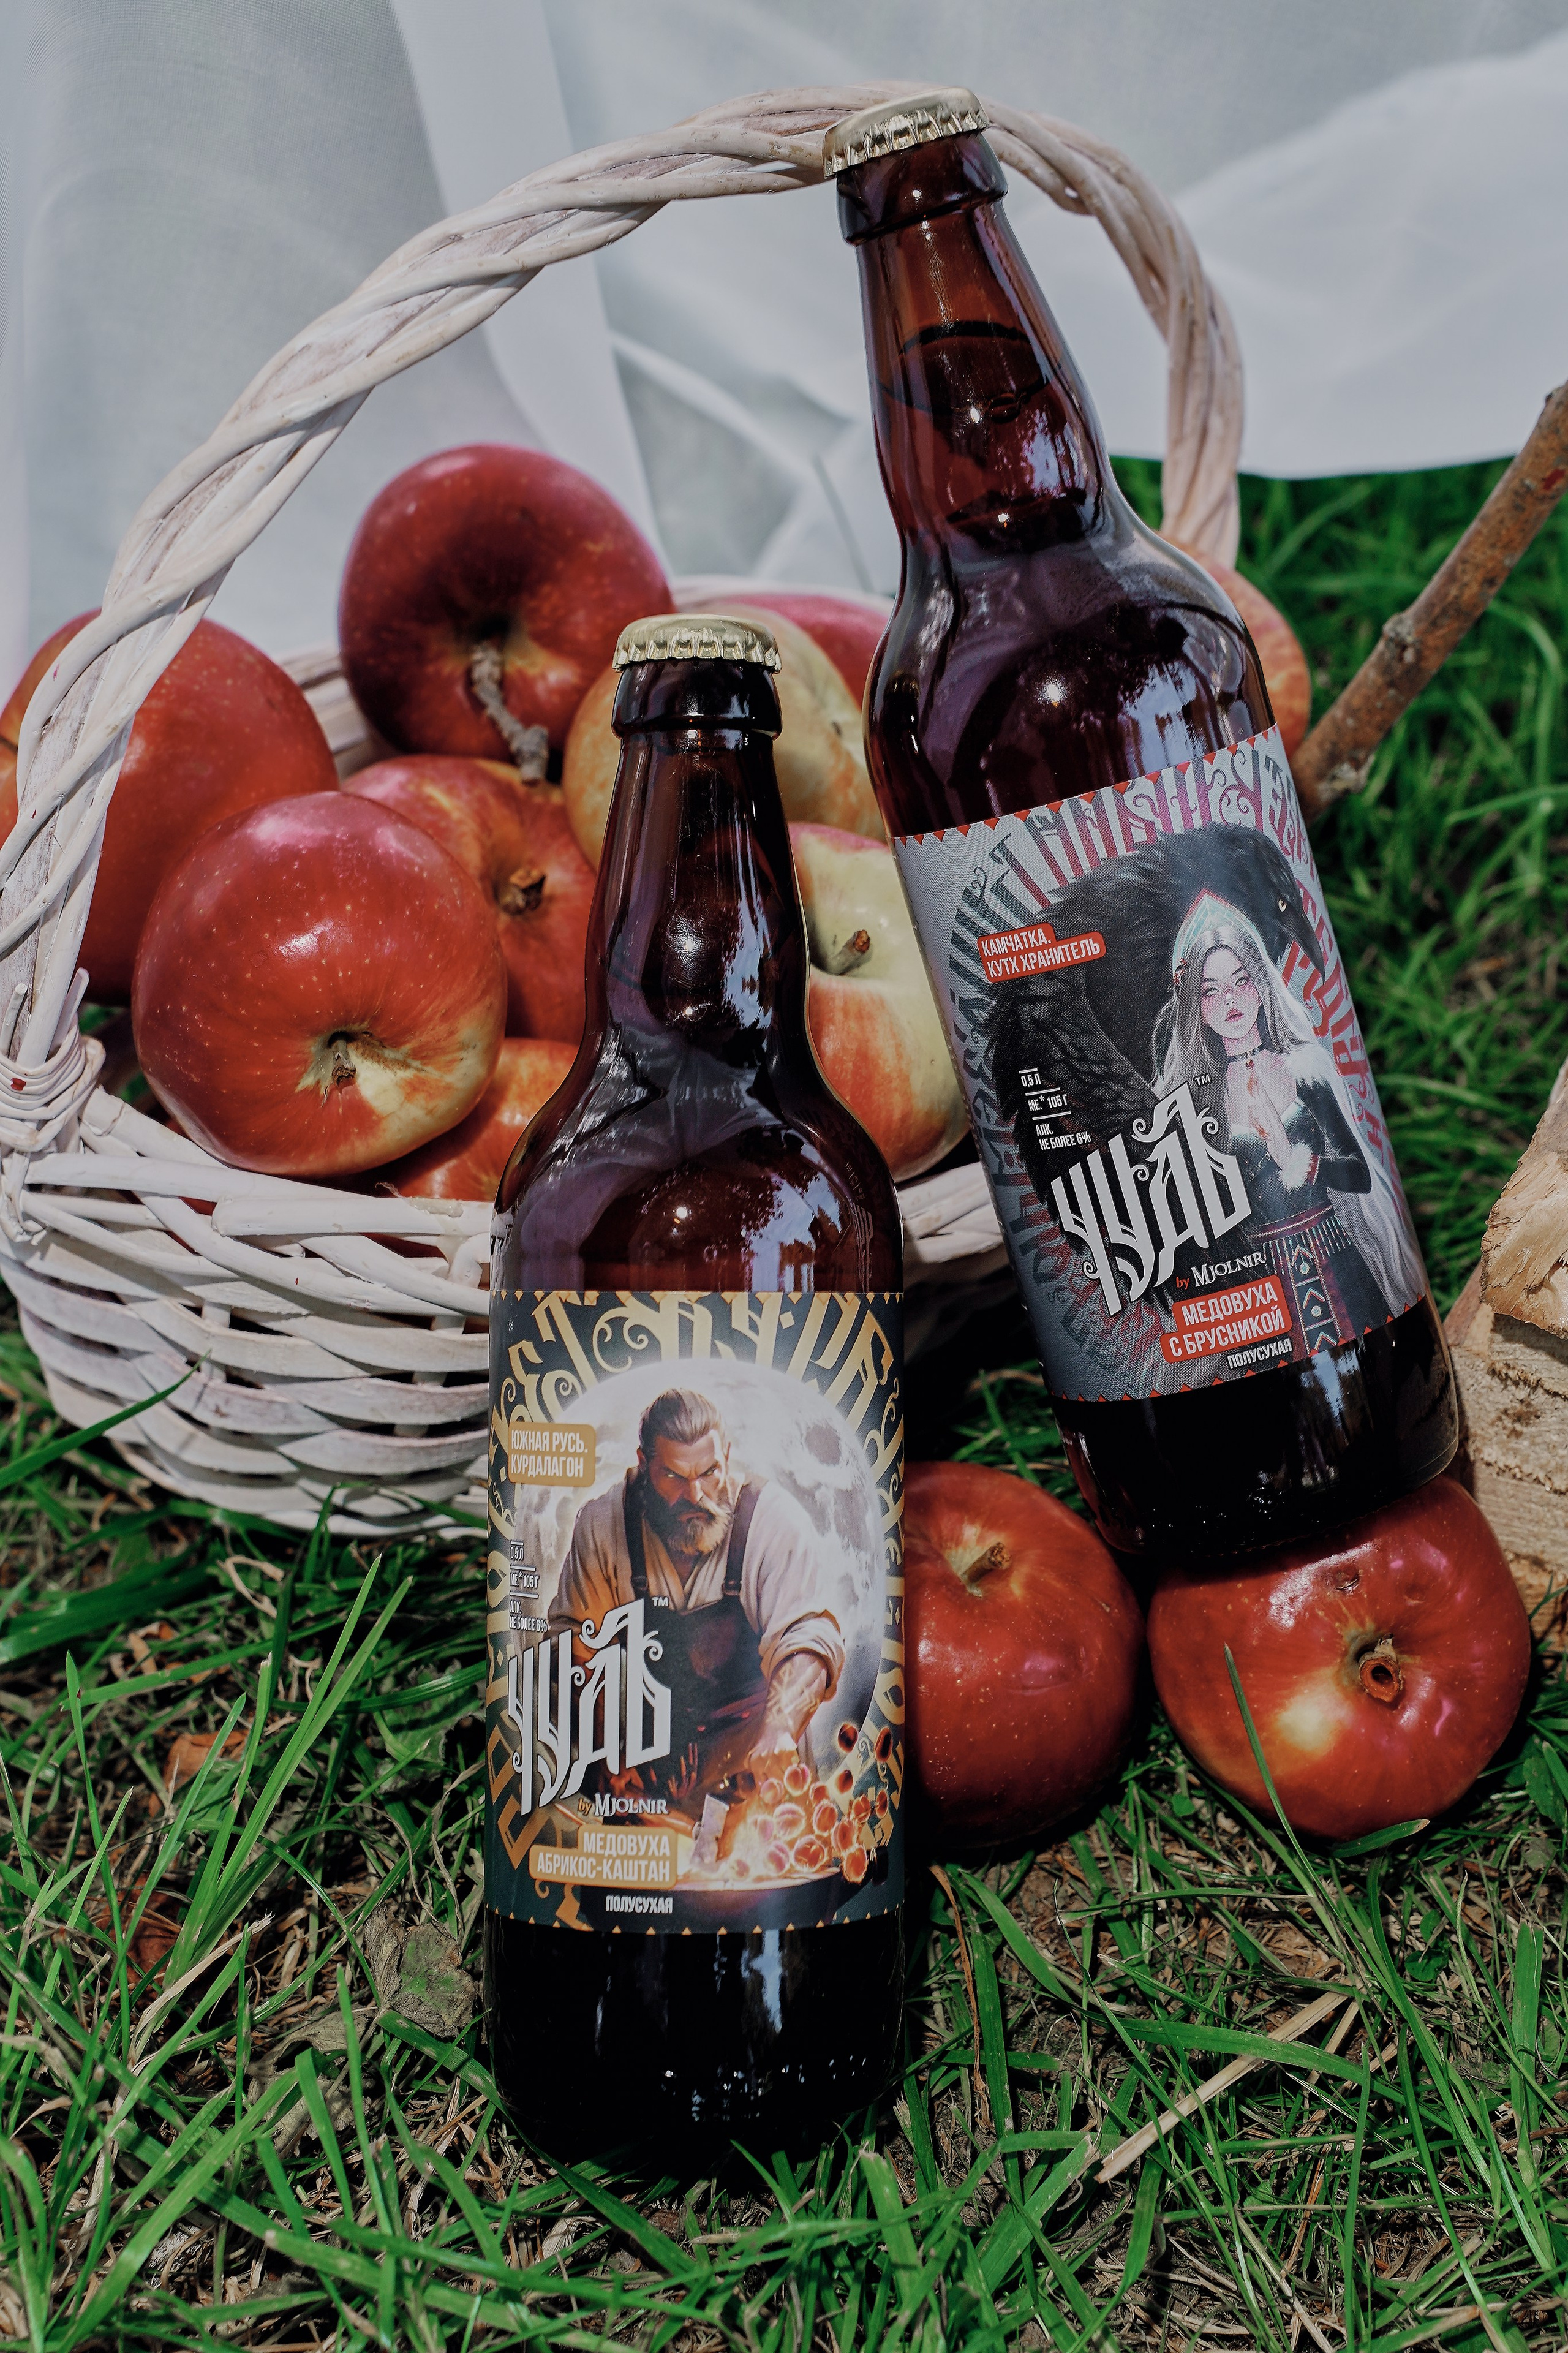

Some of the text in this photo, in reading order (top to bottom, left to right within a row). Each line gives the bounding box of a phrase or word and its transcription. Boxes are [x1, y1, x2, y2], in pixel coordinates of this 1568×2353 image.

[981, 928, 1051, 957] КАМЧАТКА.
[987, 938, 1101, 978] КУТХ ХРАНИТЕЛЬ
[1020, 1073, 1041, 1087] 0,5 Л
[1047, 1096, 1063, 1108] 105
[1062, 1094, 1067, 1106] Г
[1036, 1123, 1054, 1136] АЛК.
[1039, 1131, 1091, 1150] НЕ БОЛЕЕ 6%
[1175, 1277, 1189, 1290] by
[1182, 1282, 1278, 1326] МЕДОВУХА
[1169, 1305, 1285, 1357] С БРУСНИКОЙ
[1227, 1337, 1293, 1369] ПОЛУСУХАЯ
[511, 1430, 588, 1454] ЮЖНАЯ РУСЬ.
[511, 1454, 584, 1478] КУРДАЛАГОН
[510, 1546, 524, 1562] 0,5 Л
[523, 1575, 535, 1588] 105
[535, 1576, 539, 1588] Г
[510, 1599, 522, 1614] АЛК.
[510, 1615, 548, 1633] НЕ БОЛЕЕ 6%
[578, 1798, 592, 1815] by
[583, 1832, 671, 1857] МЕДОВУХА
[537, 1852, 670, 1883] АБРИКОС-КАШТАН
[606, 1895, 673, 1914] ПОЛУСУХАЯ
